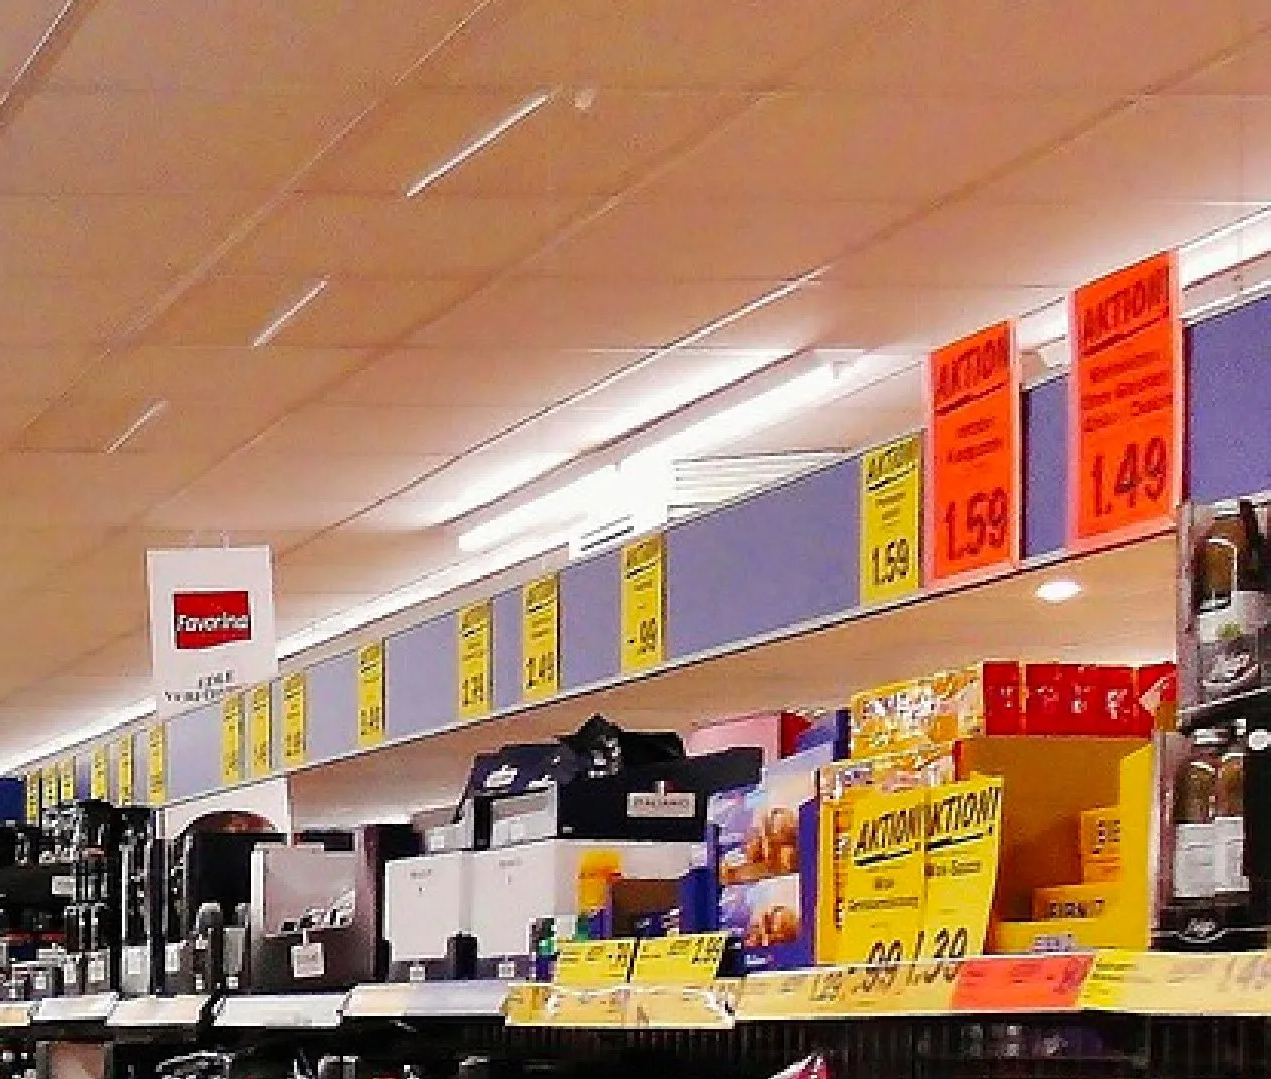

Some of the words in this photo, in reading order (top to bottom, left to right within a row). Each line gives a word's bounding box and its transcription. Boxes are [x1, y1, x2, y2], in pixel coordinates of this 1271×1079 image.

[1092, 436, 1167, 517] 1.49
[945, 487, 1008, 561] 1.59
[871, 538, 910, 586] 1.59
[176, 613, 249, 633] Favorina
[908, 926, 969, 986] 1.39
